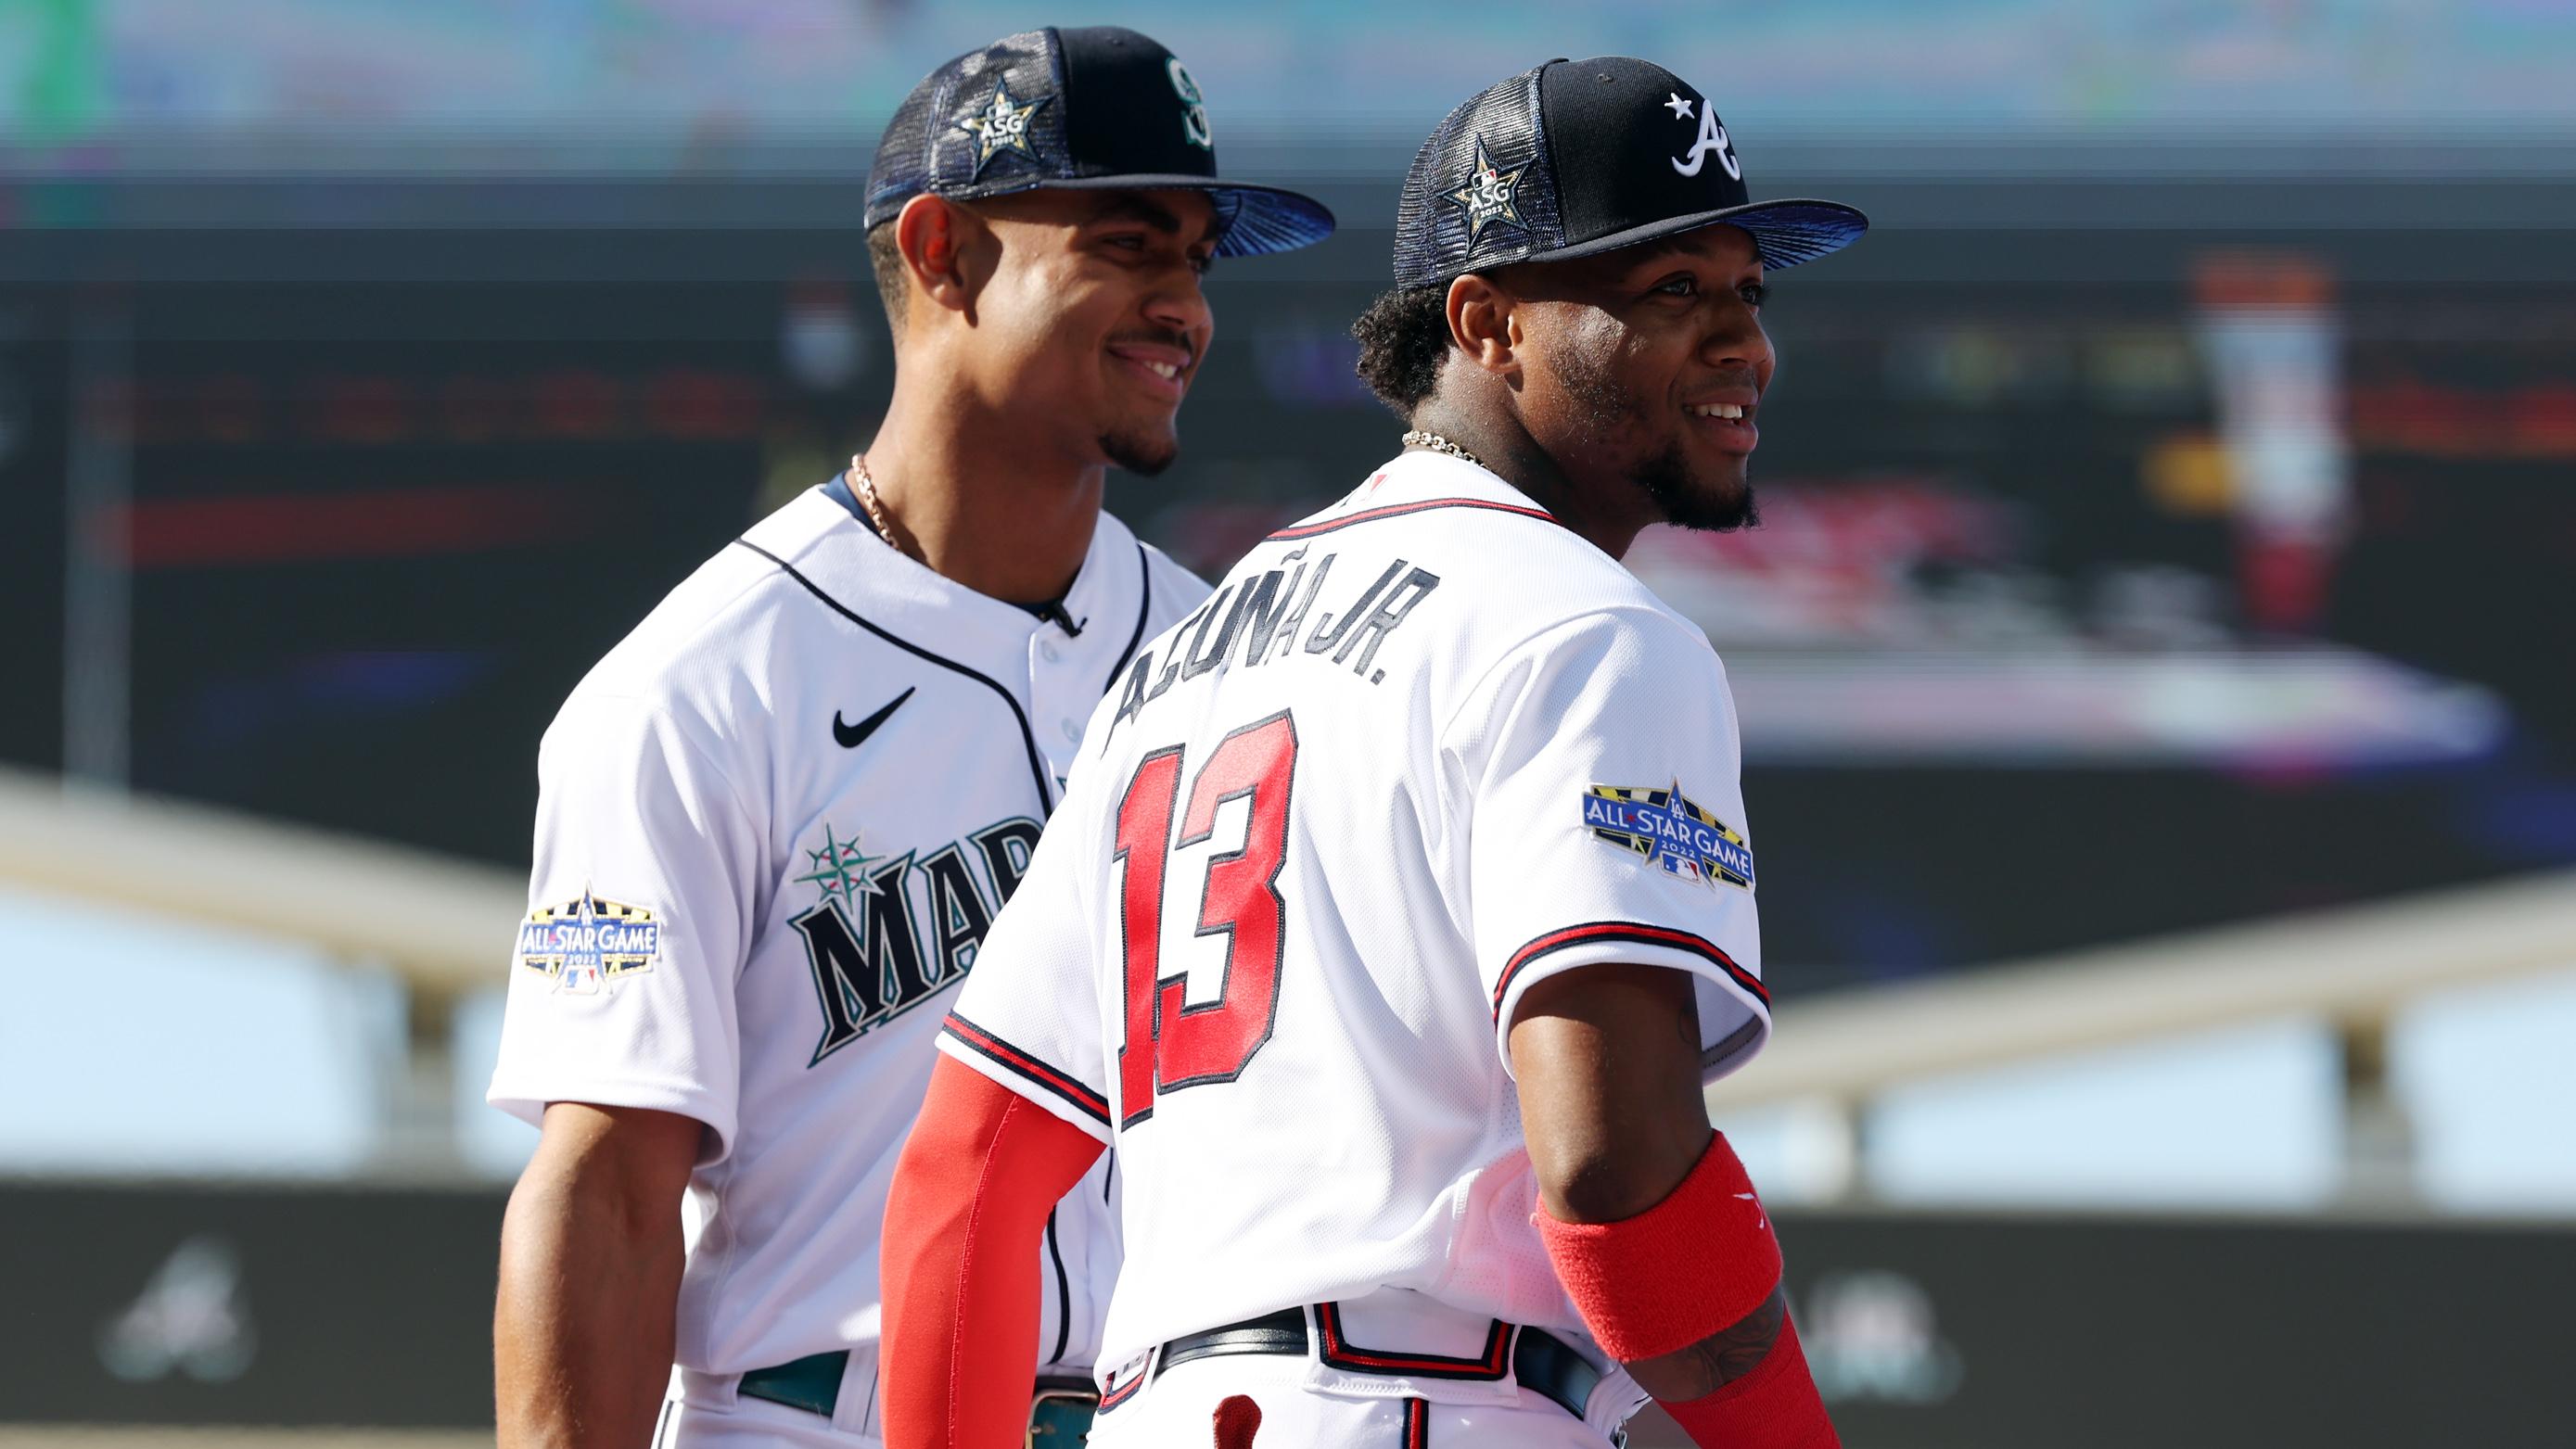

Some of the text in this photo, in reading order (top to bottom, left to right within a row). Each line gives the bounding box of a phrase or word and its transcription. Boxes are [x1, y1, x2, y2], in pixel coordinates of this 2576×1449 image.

[980, 114, 1024, 140] ASG
[1672, 99, 1741, 181] A
[1470, 182, 1510, 213] ASG
[1480, 205, 1503, 218] 2022
[1305, 558, 1440, 685] JR.
[1670, 798, 1685, 821] LA
[1587, 799, 1750, 876] ALL STAR GAME
[1662, 841, 1696, 858] 2022
[1112, 707, 1298, 1132] 13
[522, 924, 655, 953] ALL STAR GAME
